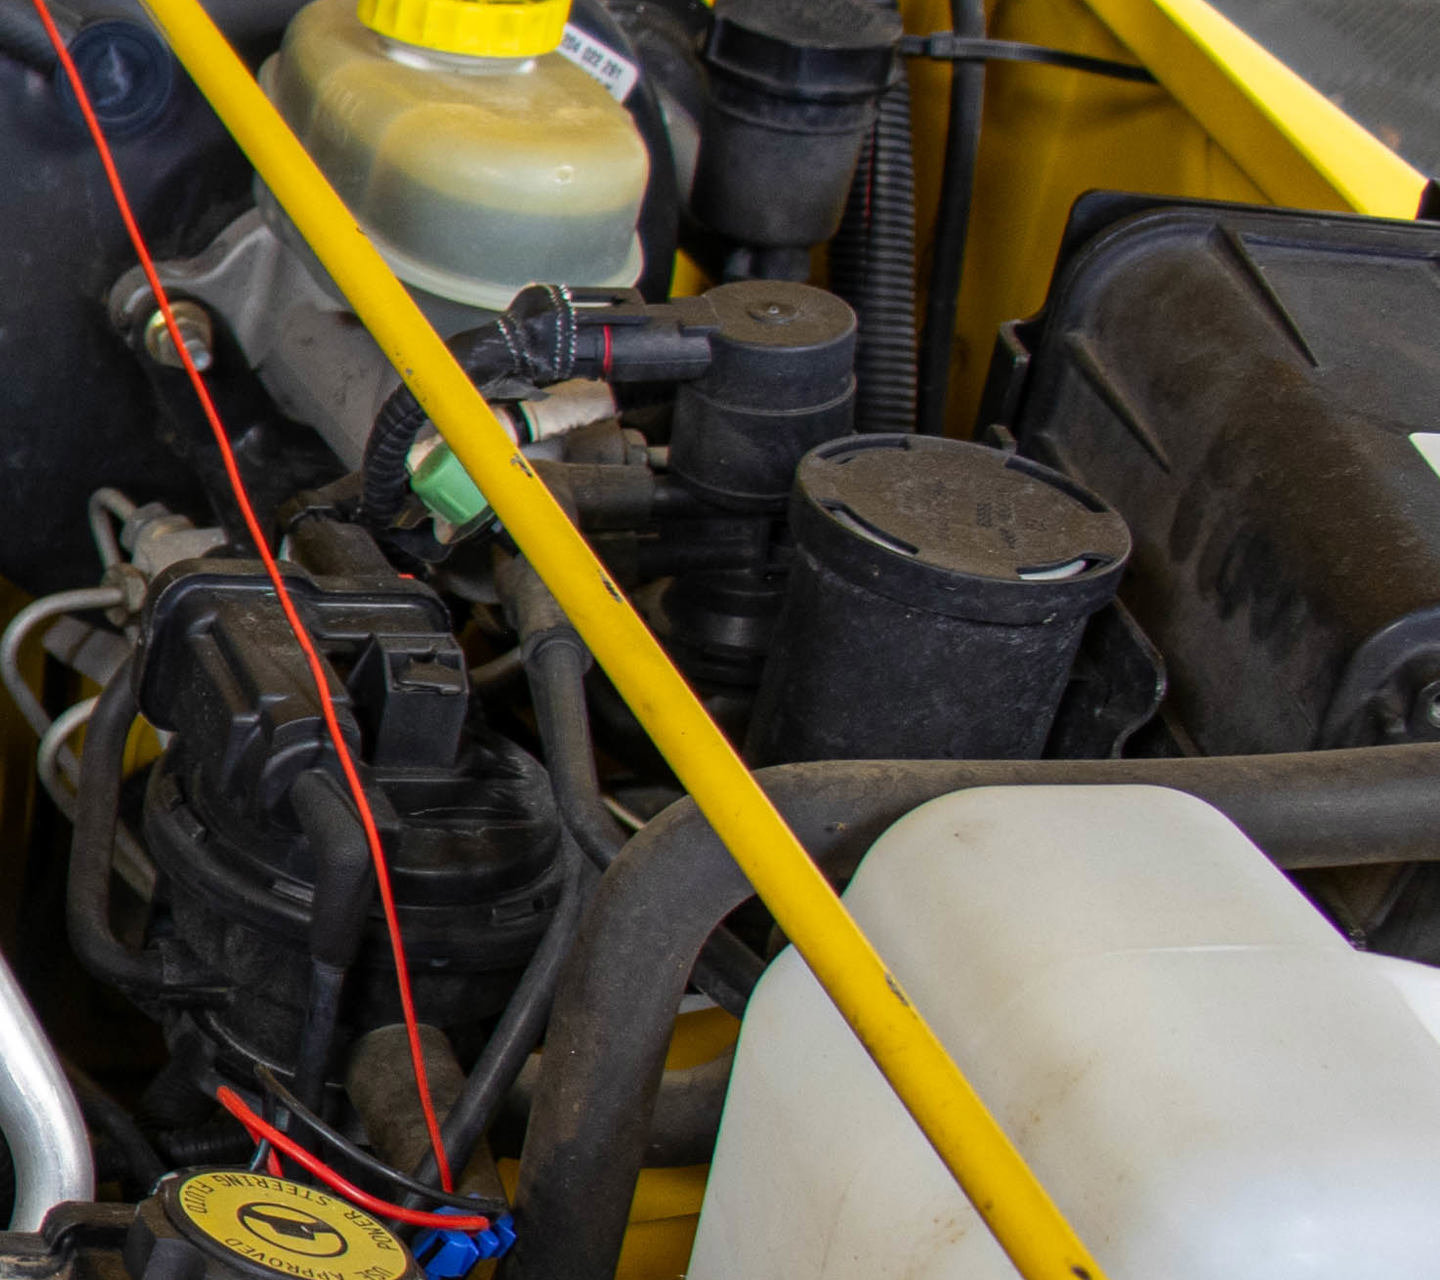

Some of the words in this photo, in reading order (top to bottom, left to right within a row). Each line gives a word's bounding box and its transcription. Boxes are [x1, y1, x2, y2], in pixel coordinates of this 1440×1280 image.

[184, 1179, 216, 1215] FLUID
[212, 1174, 333, 1207] STEERING
[343, 1209, 399, 1252] POWER
